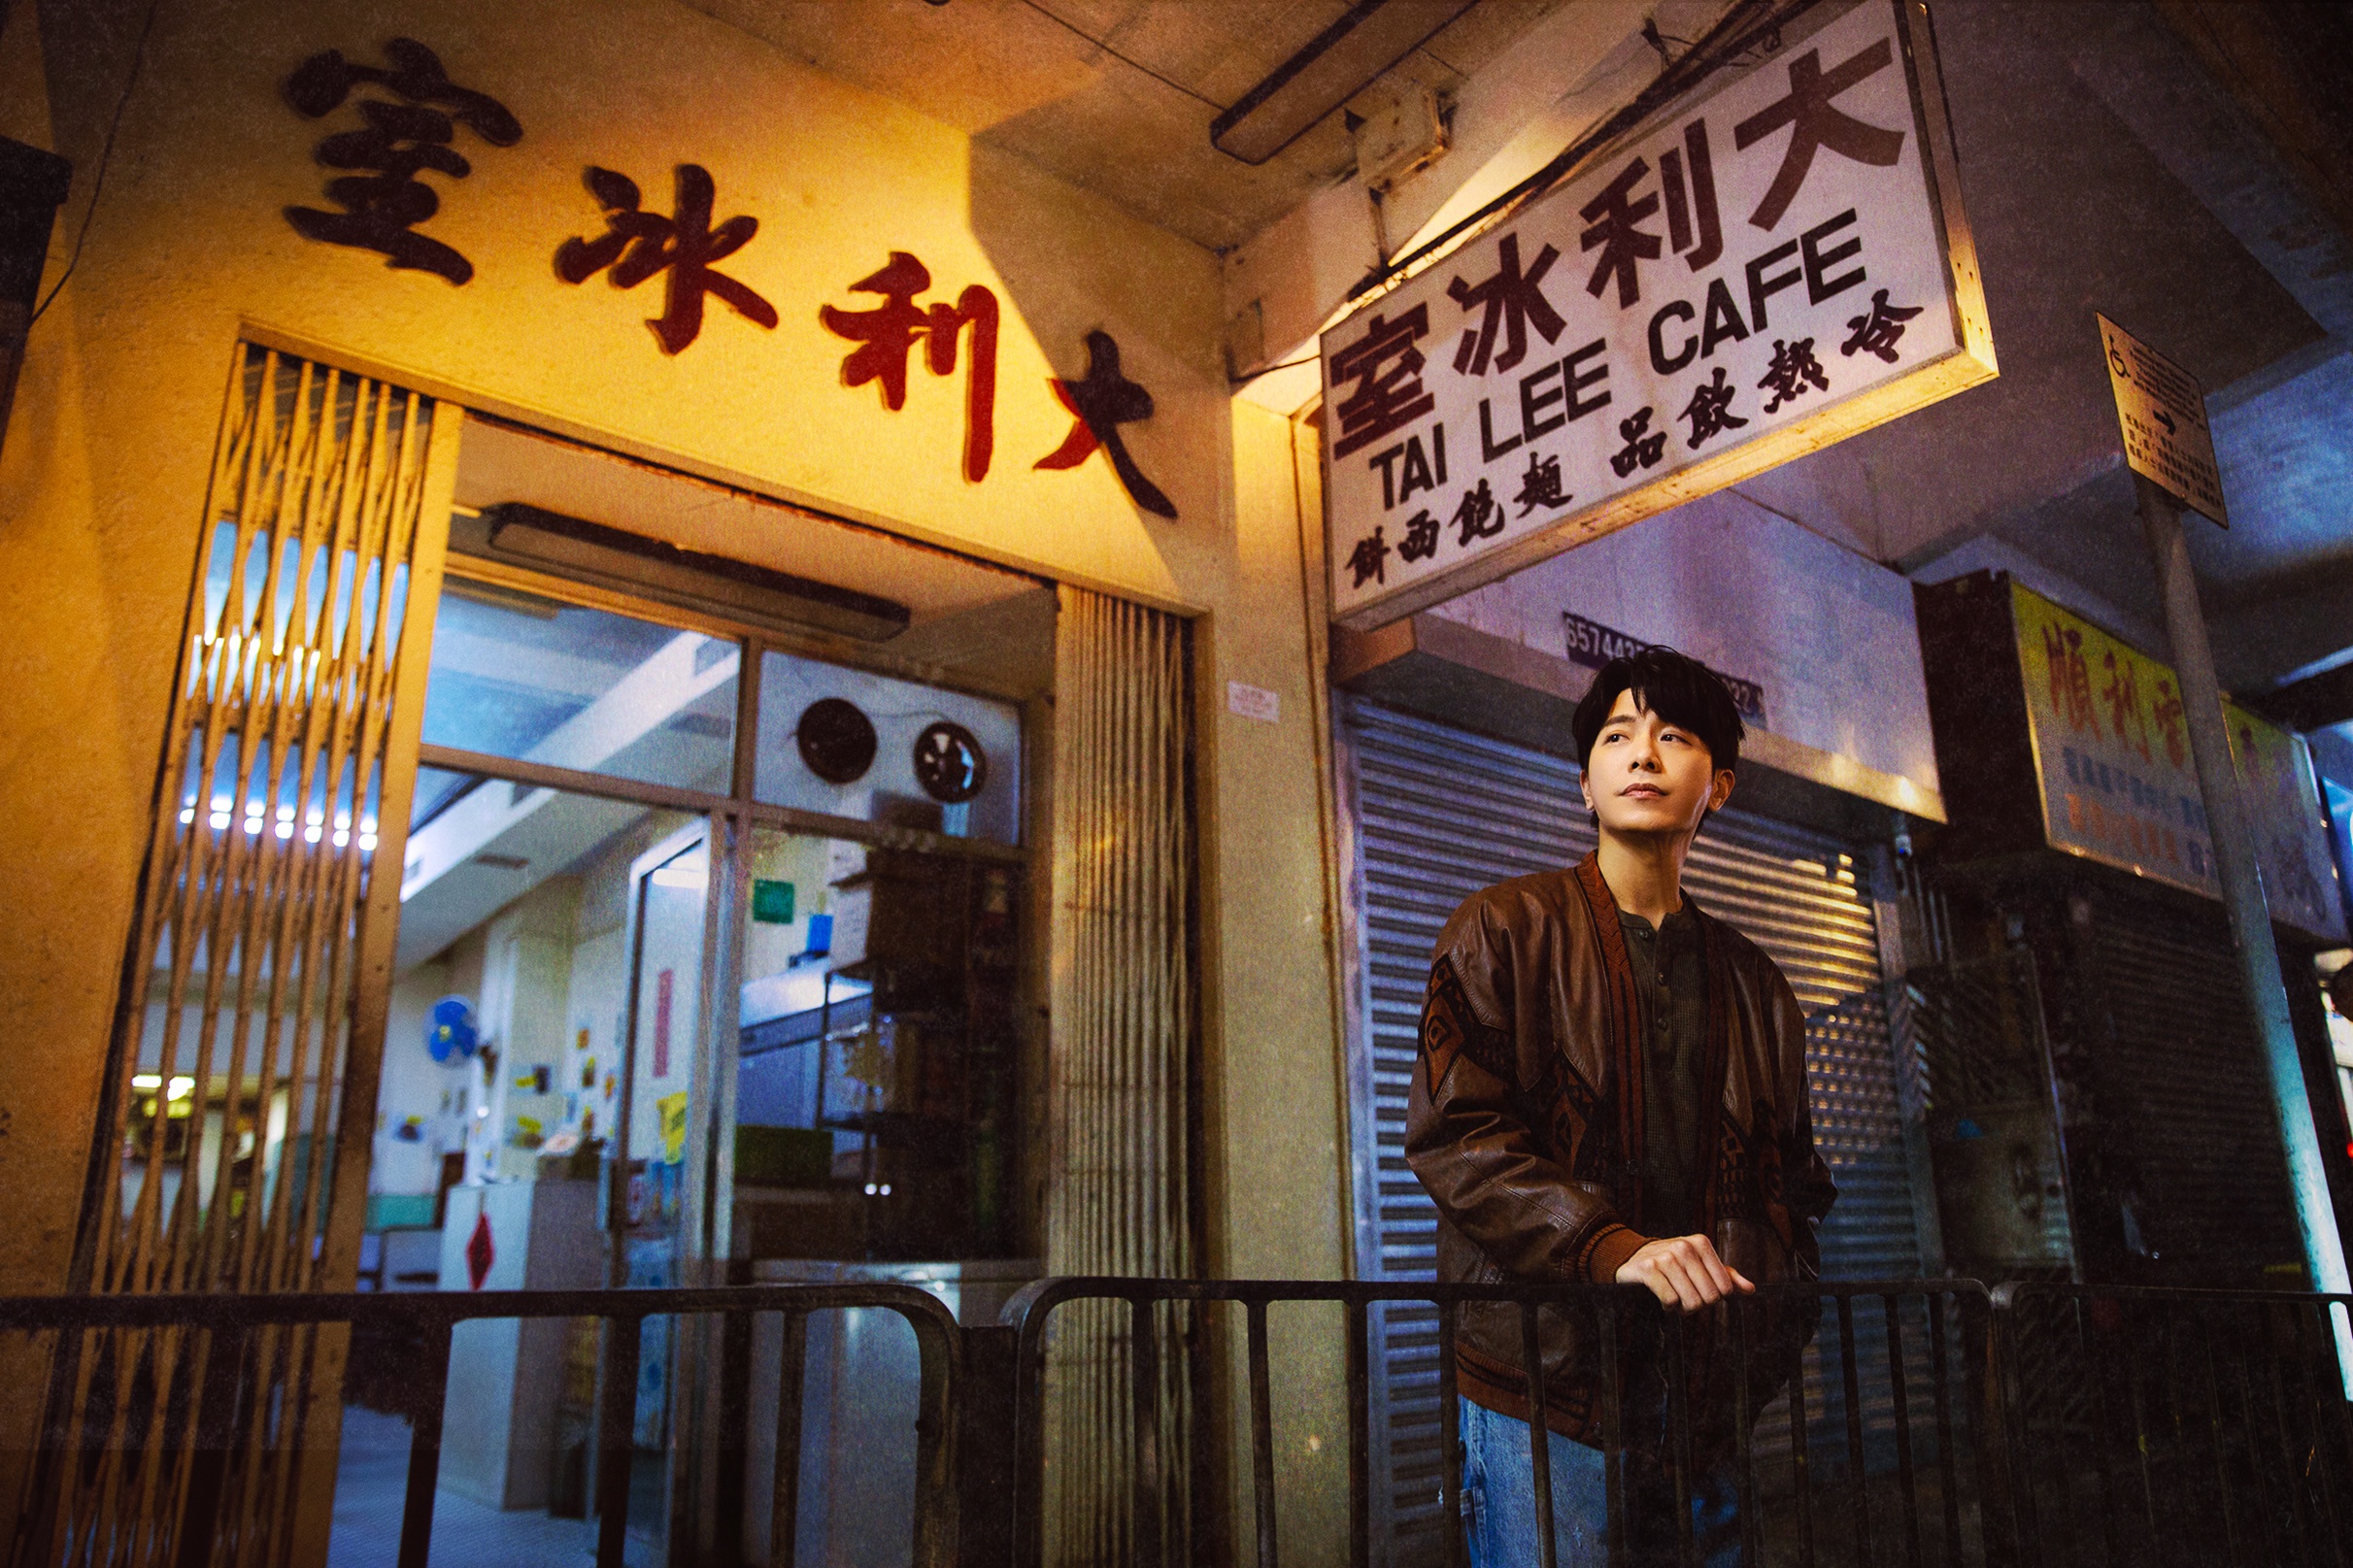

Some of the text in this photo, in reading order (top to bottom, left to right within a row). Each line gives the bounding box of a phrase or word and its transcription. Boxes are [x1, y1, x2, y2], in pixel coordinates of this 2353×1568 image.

[281, 37, 1178, 521] 大利冰室
[1328, 37, 1907, 462] 大利冰室
[1369, 207, 1867, 512] TAI LEE CAFE
